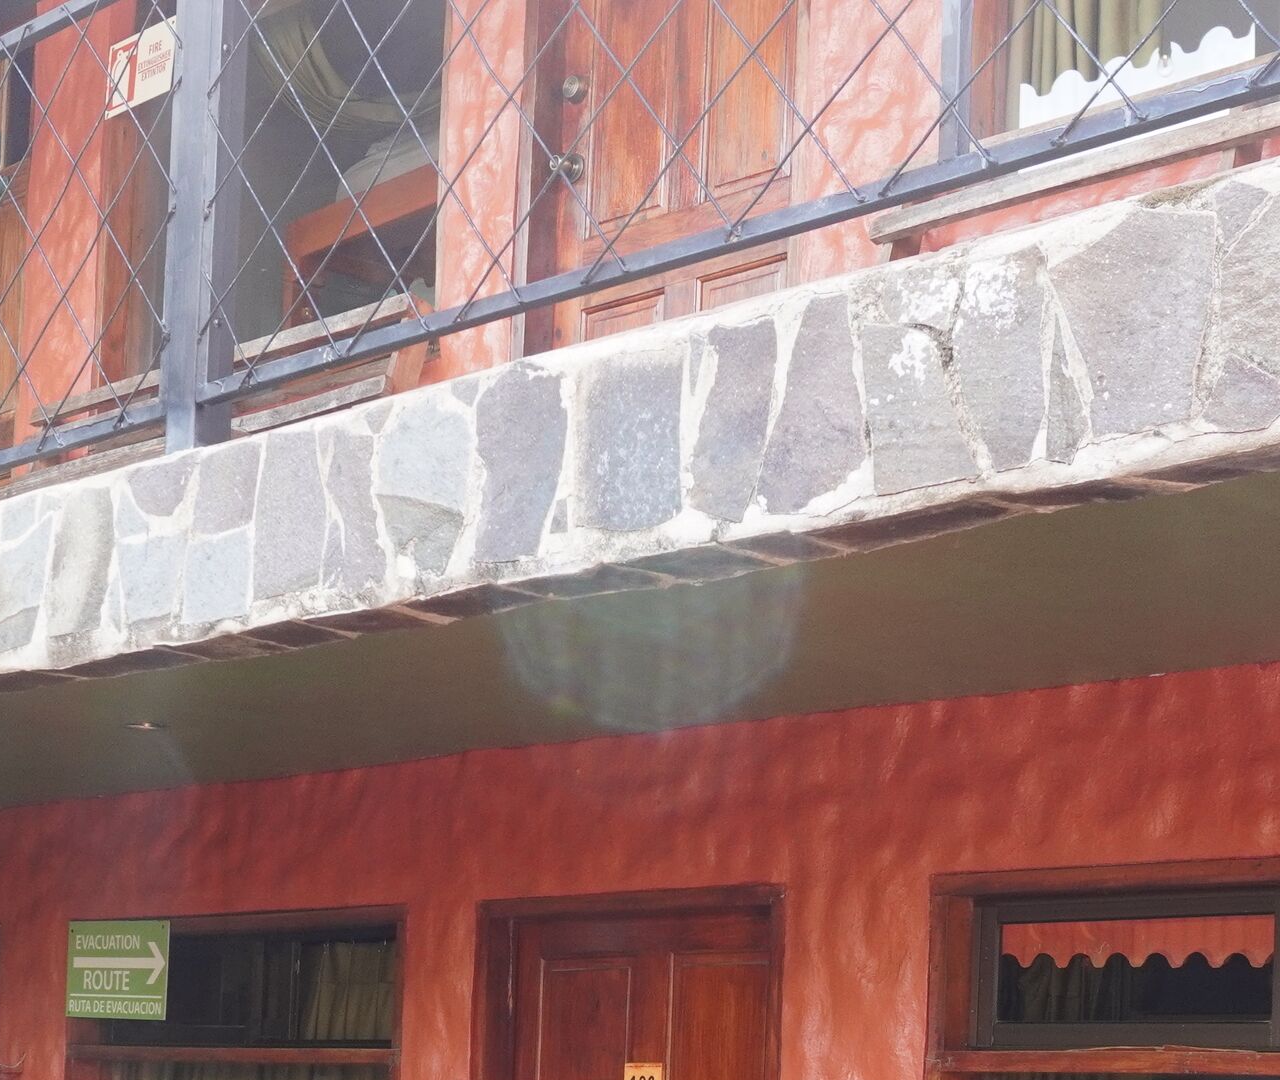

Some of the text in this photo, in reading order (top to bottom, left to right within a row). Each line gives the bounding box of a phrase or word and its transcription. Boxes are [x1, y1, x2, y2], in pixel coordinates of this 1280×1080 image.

[148, 40, 162, 55] FIRE
[141, 62, 167, 81] EXTINTOR
[75, 934, 140, 950] EVACUATION
[83, 970, 130, 991] ROUTE
[69, 999, 162, 1015] RUTA DE EVACUACION
